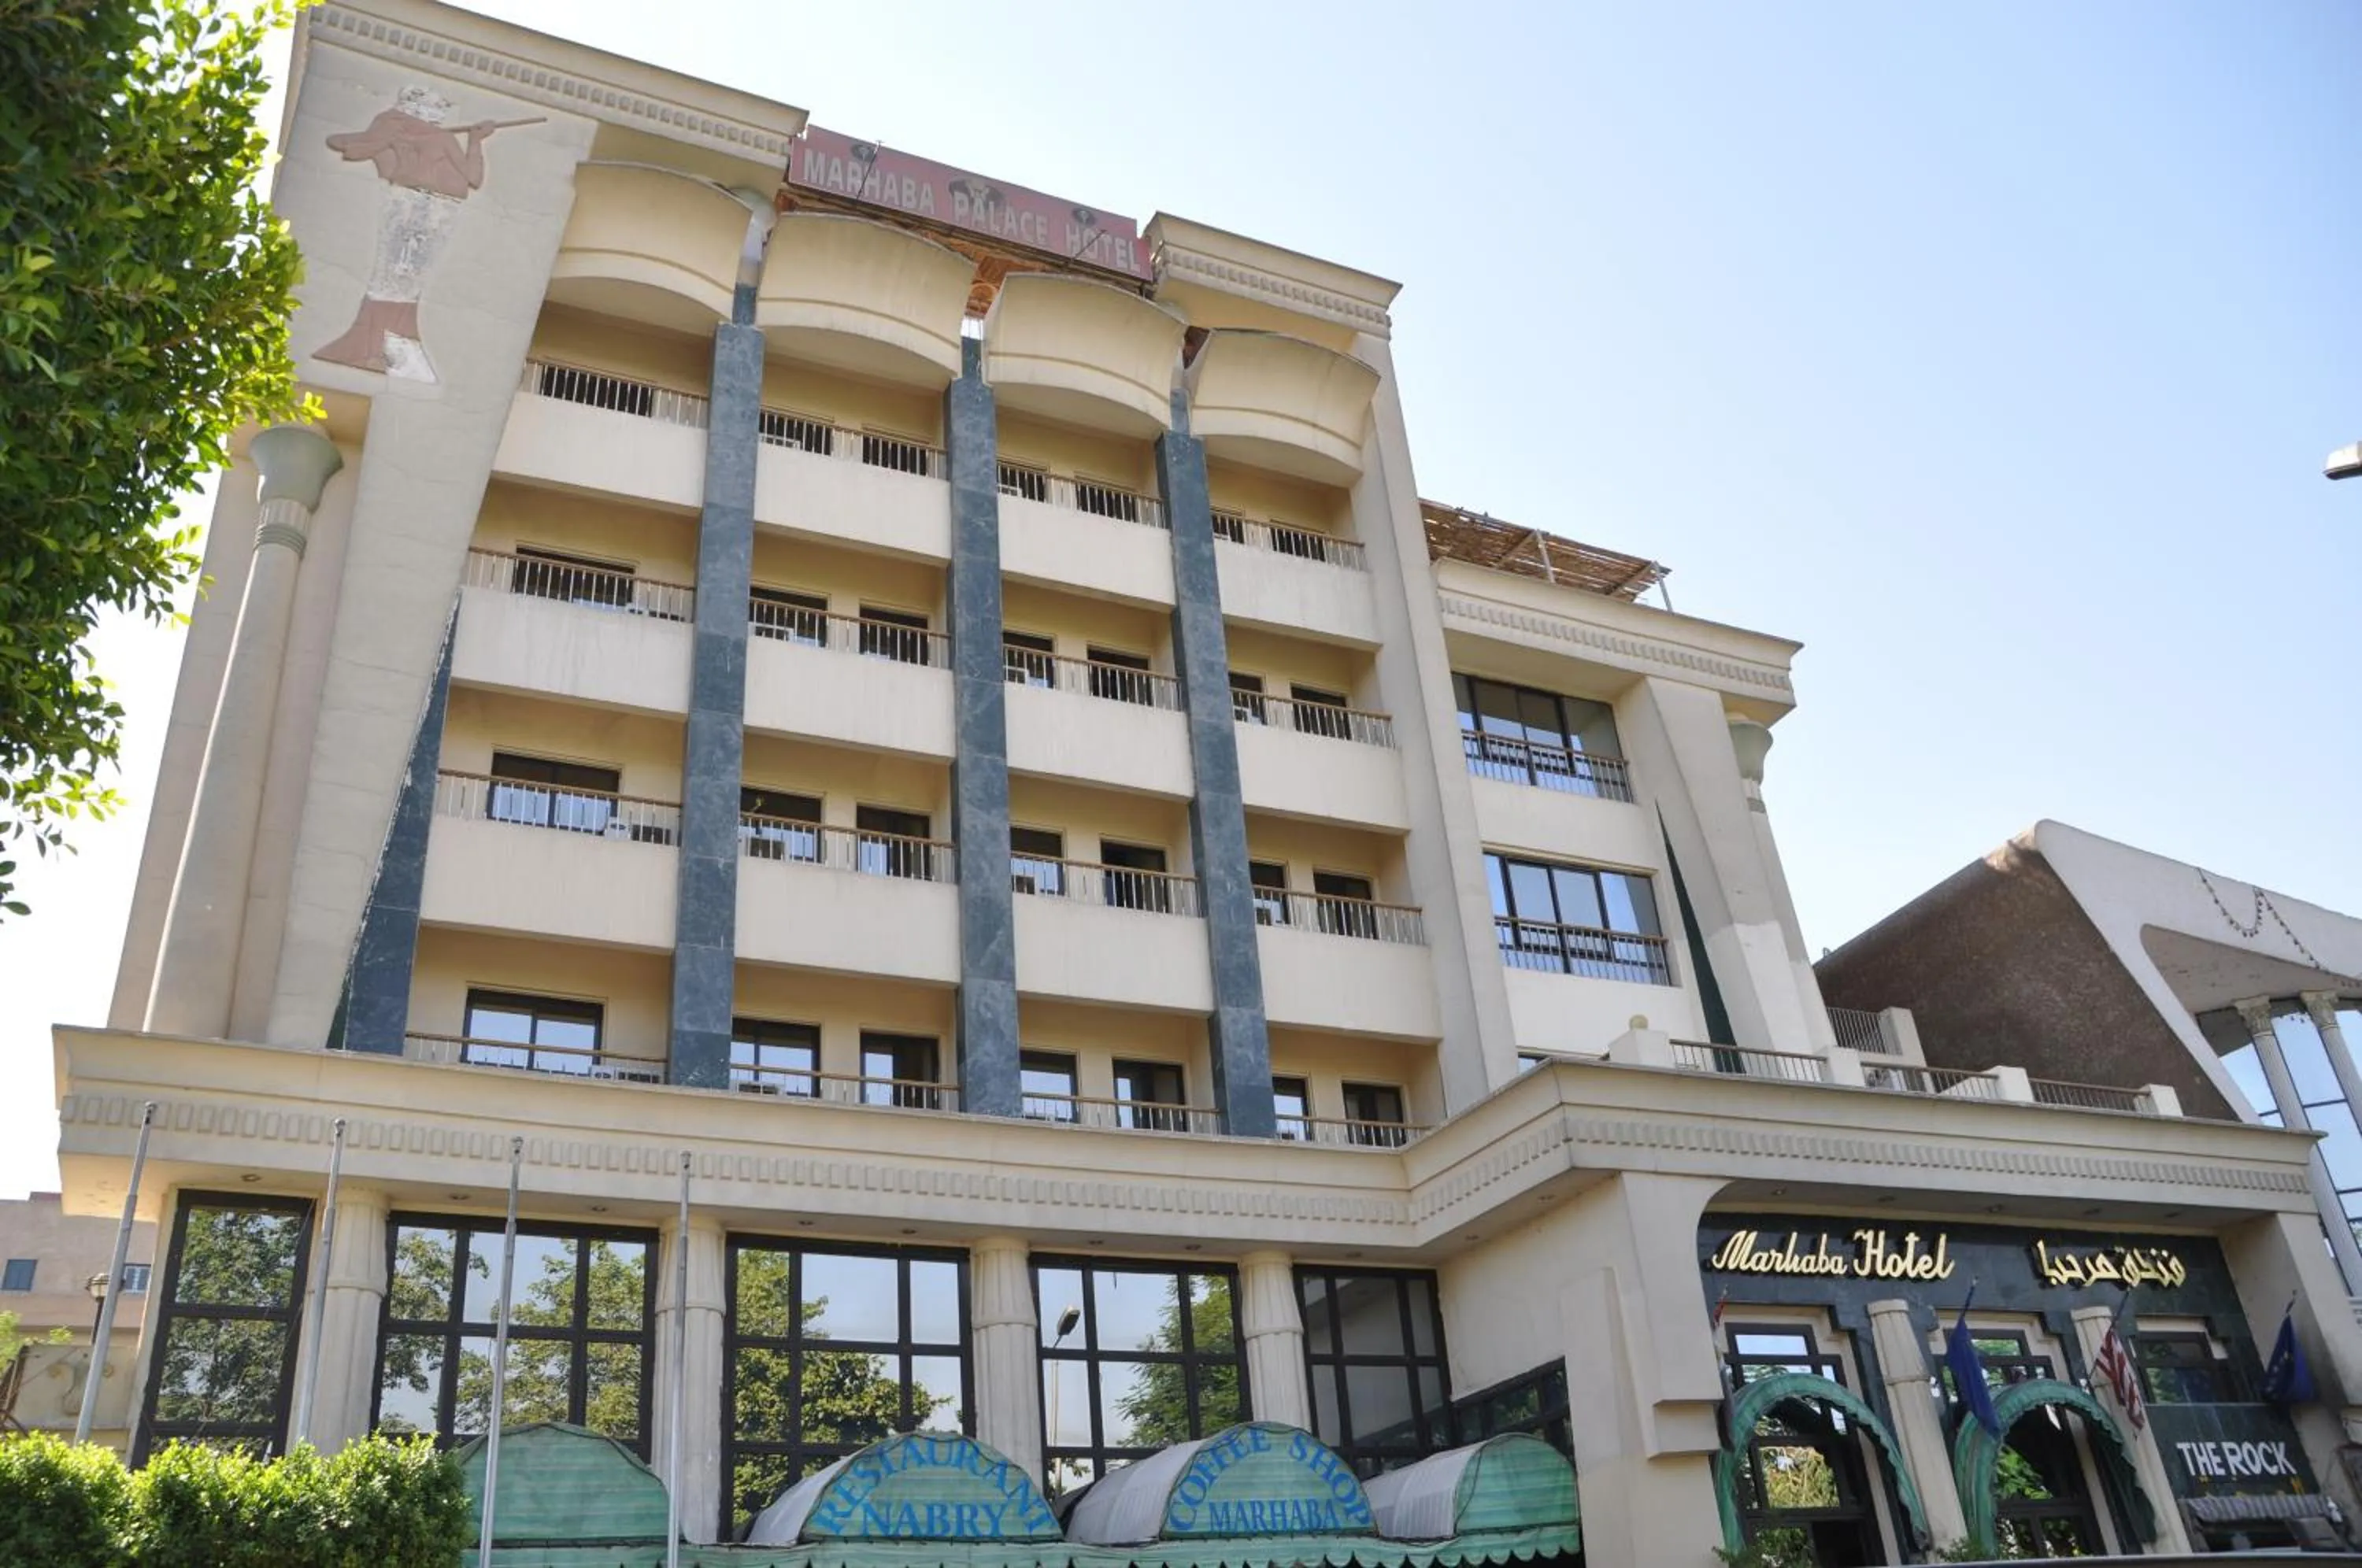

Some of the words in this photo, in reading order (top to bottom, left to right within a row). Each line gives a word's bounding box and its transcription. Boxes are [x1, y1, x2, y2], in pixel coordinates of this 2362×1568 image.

[803, 149, 935, 216] MARHABA
[953, 191, 1049, 246] PALACE
[1065, 224, 1141, 273] HOTEL
[1712, 1230, 1848, 1275] Marhaba
[1853, 1229, 1955, 1280] Hotel
[2036, 1239, 2123, 1287] مرحبا
[1168, 1426, 1272, 1531] COFFEE
[1288, 1429, 1371, 1525] SHOP
[2176, 1441, 2227, 1477] THE
[2220, 1441, 2297, 1477] ROCK
[813, 1435, 1058, 1535] RESTAURANT
[857, 1501, 1008, 1537] NABRY
[1208, 1498, 1342, 1532] MARHABA
